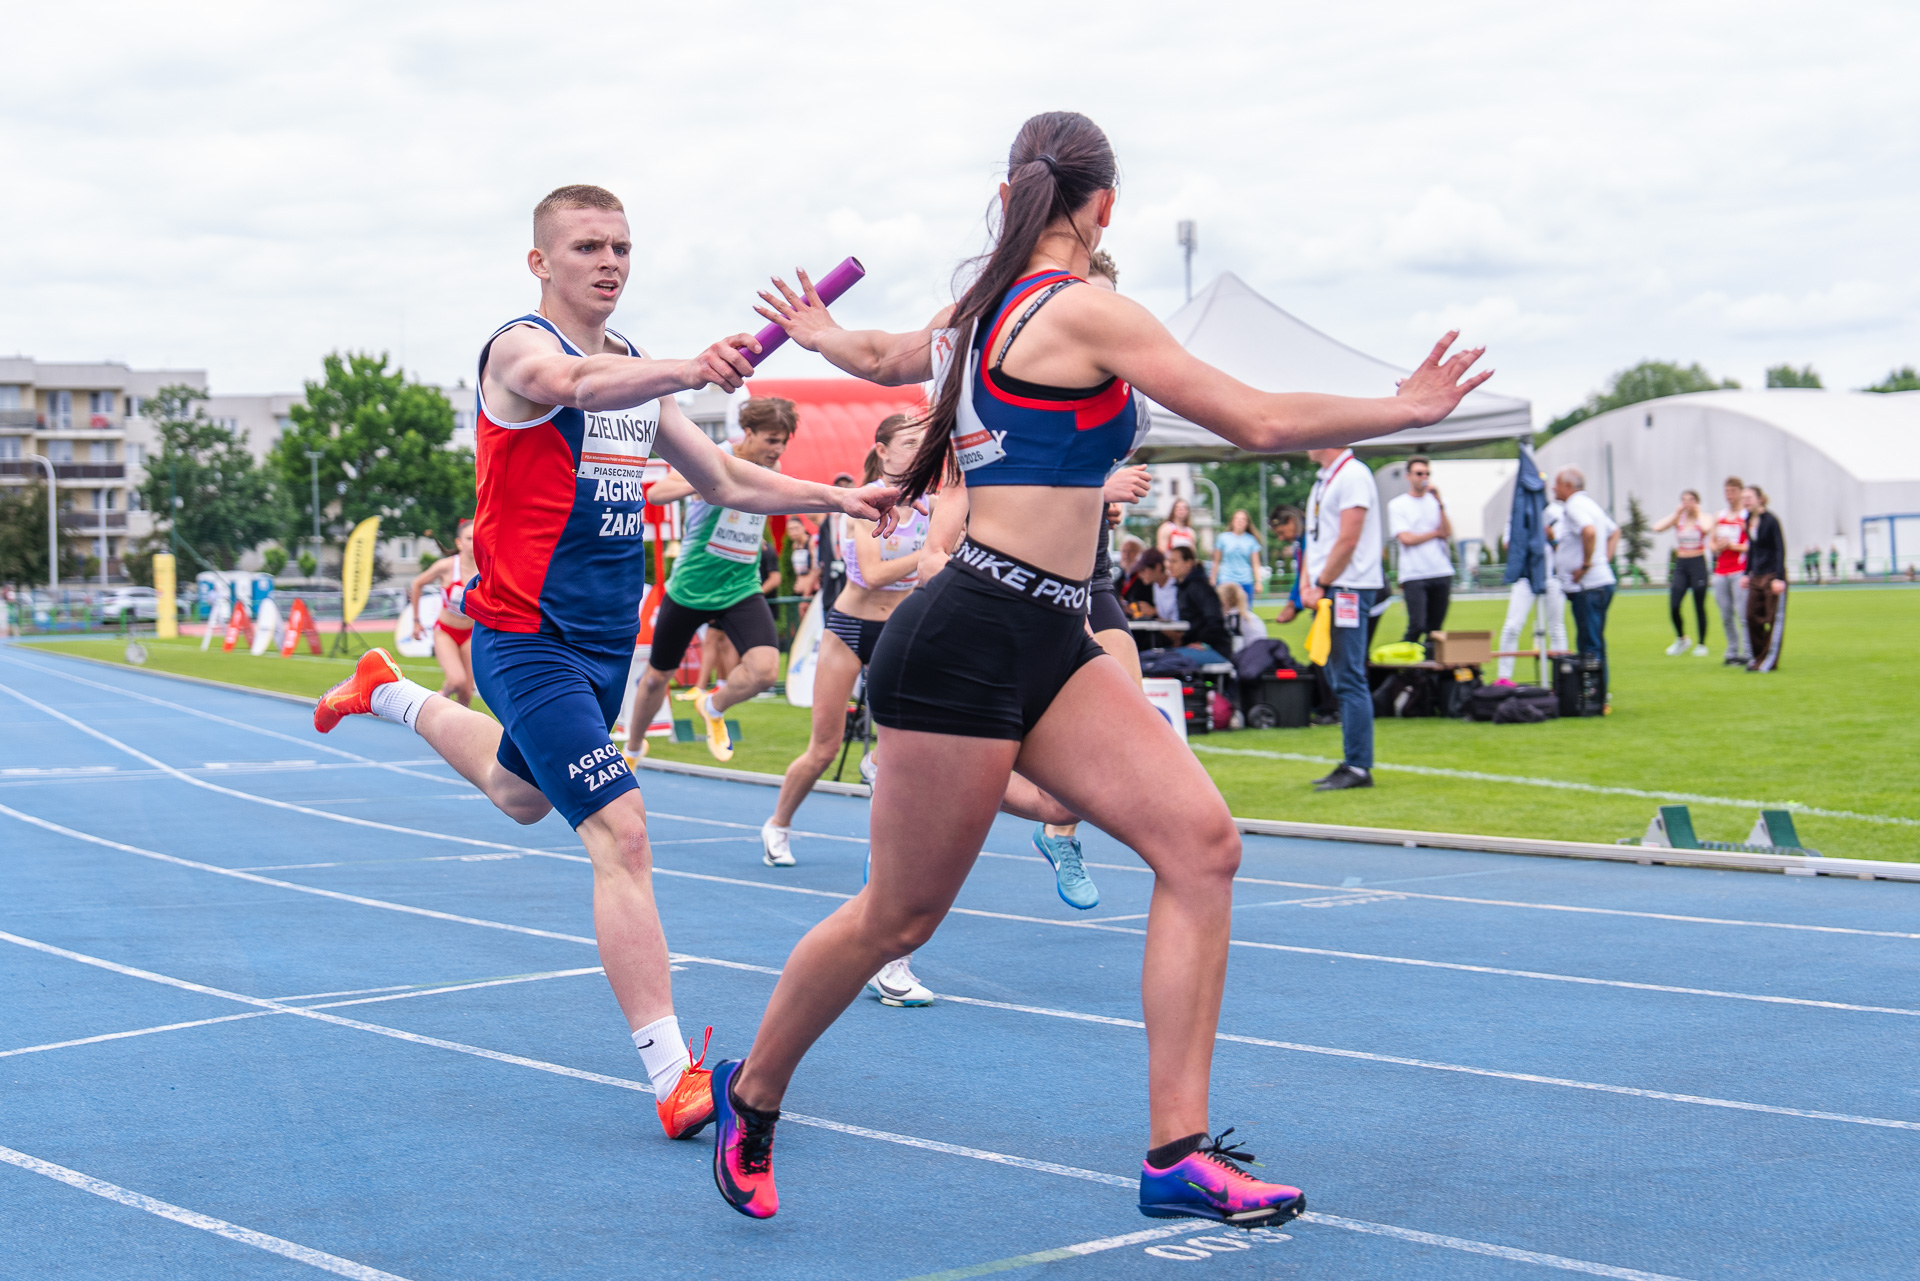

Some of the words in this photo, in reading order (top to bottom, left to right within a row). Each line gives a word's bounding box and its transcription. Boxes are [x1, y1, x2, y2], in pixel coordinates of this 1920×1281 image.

[587, 414, 657, 444] ZIELIŃSKI
[593, 466, 636, 478] PIASECZNO
[599, 507, 641, 537] ŻARY
[956, 541, 1037, 592] NIKE
[1032, 578, 1086, 609] PRO
[583, 759, 629, 792] ŻARY
